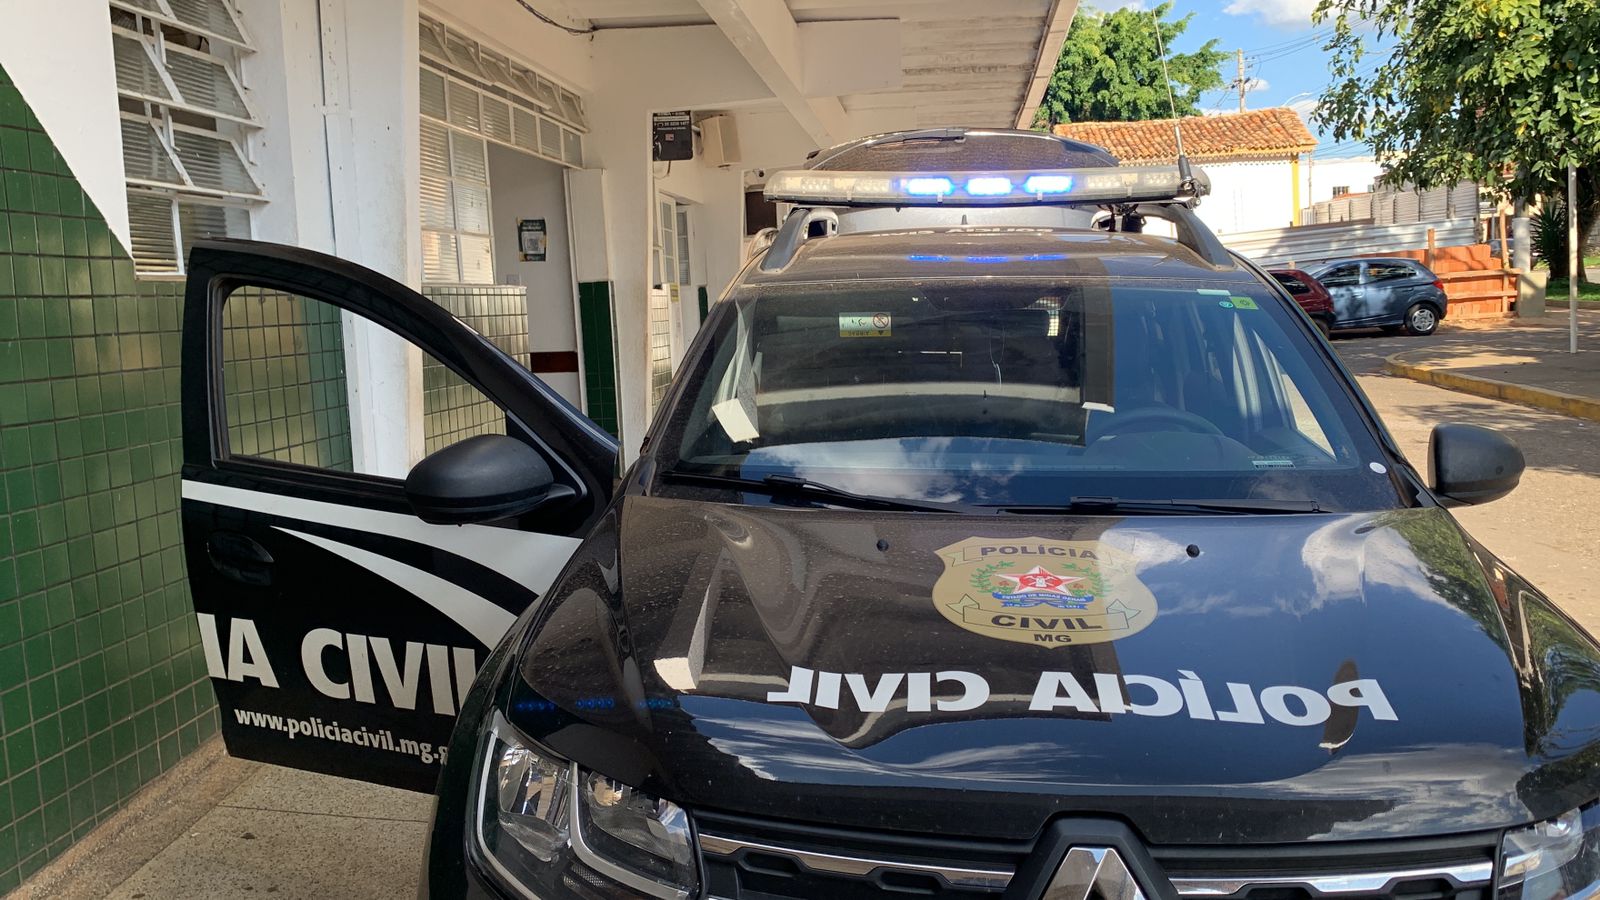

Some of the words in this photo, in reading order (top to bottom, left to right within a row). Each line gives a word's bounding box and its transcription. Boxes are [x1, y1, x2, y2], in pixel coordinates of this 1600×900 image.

[981, 545, 1099, 558] POLÍCIA
[991, 615, 1103, 629] CIVIL
[1034, 634, 1072, 643] MG
